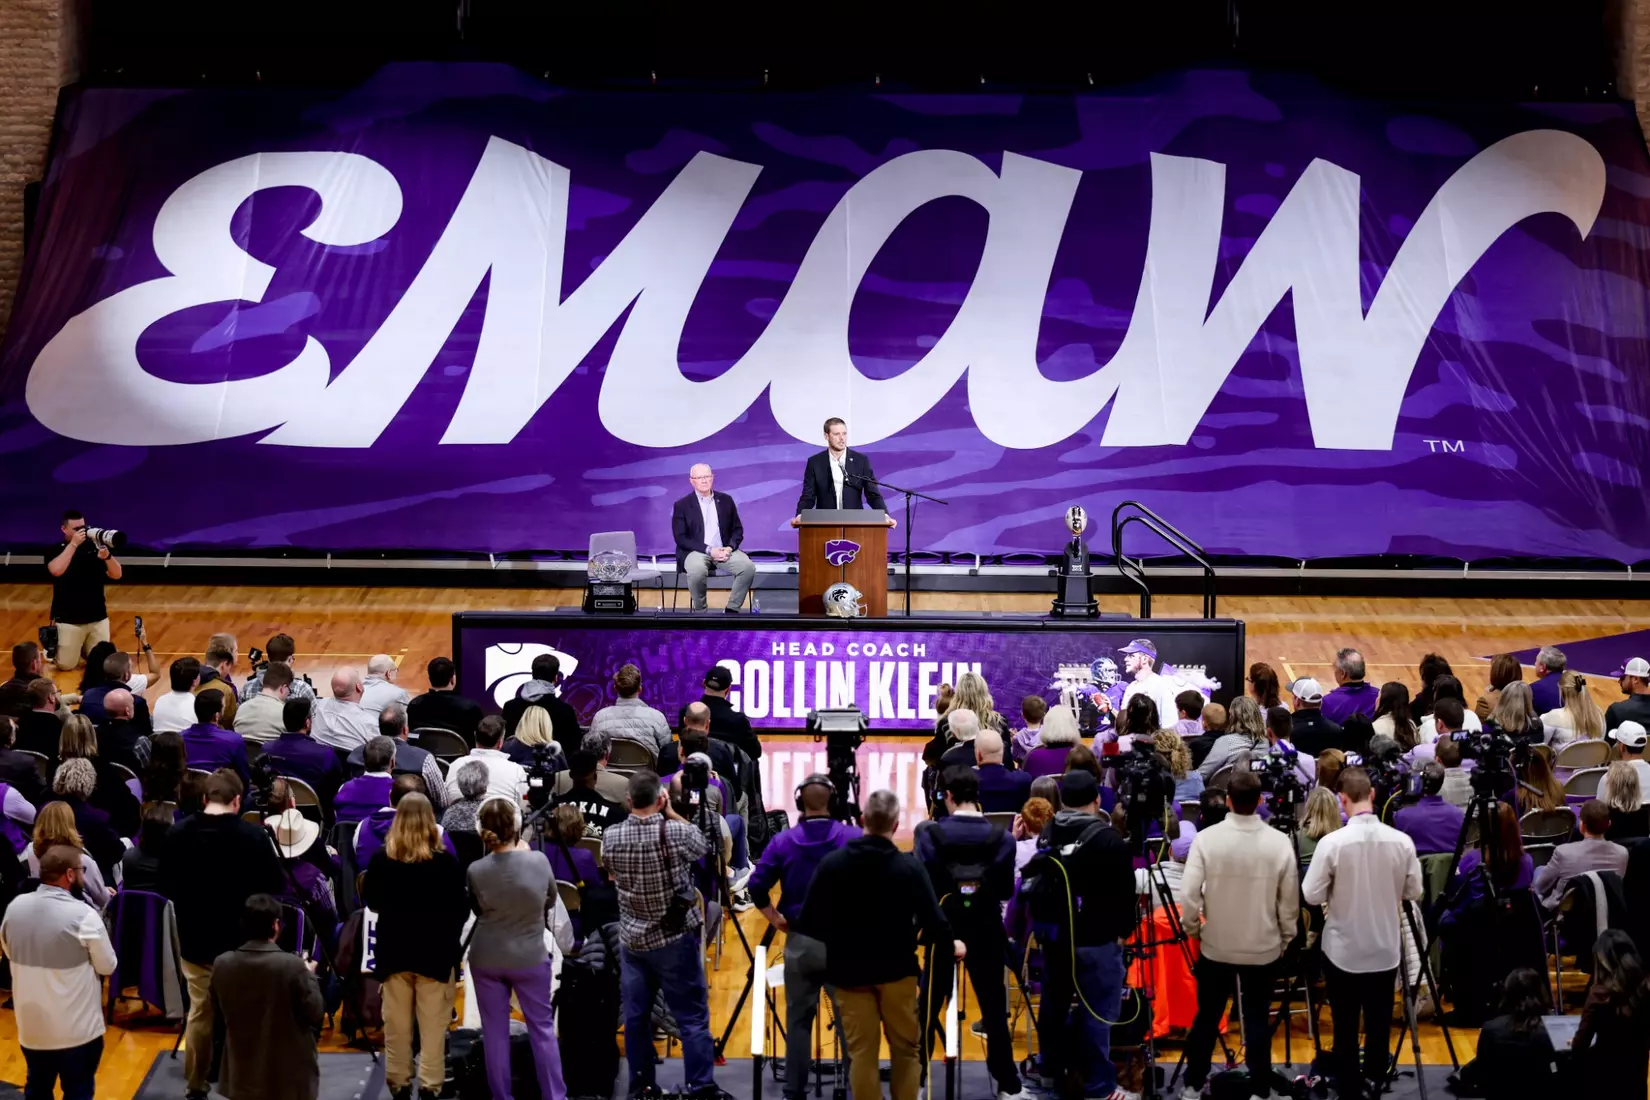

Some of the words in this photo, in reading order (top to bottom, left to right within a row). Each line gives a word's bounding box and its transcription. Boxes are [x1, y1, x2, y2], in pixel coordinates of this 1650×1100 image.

[1423, 439, 1465, 453] TM
[772, 642, 835, 656] HEAD
[847, 643, 927, 657] COACH
[869, 661, 982, 720] KLE
[559, 801, 609, 817] KAN
